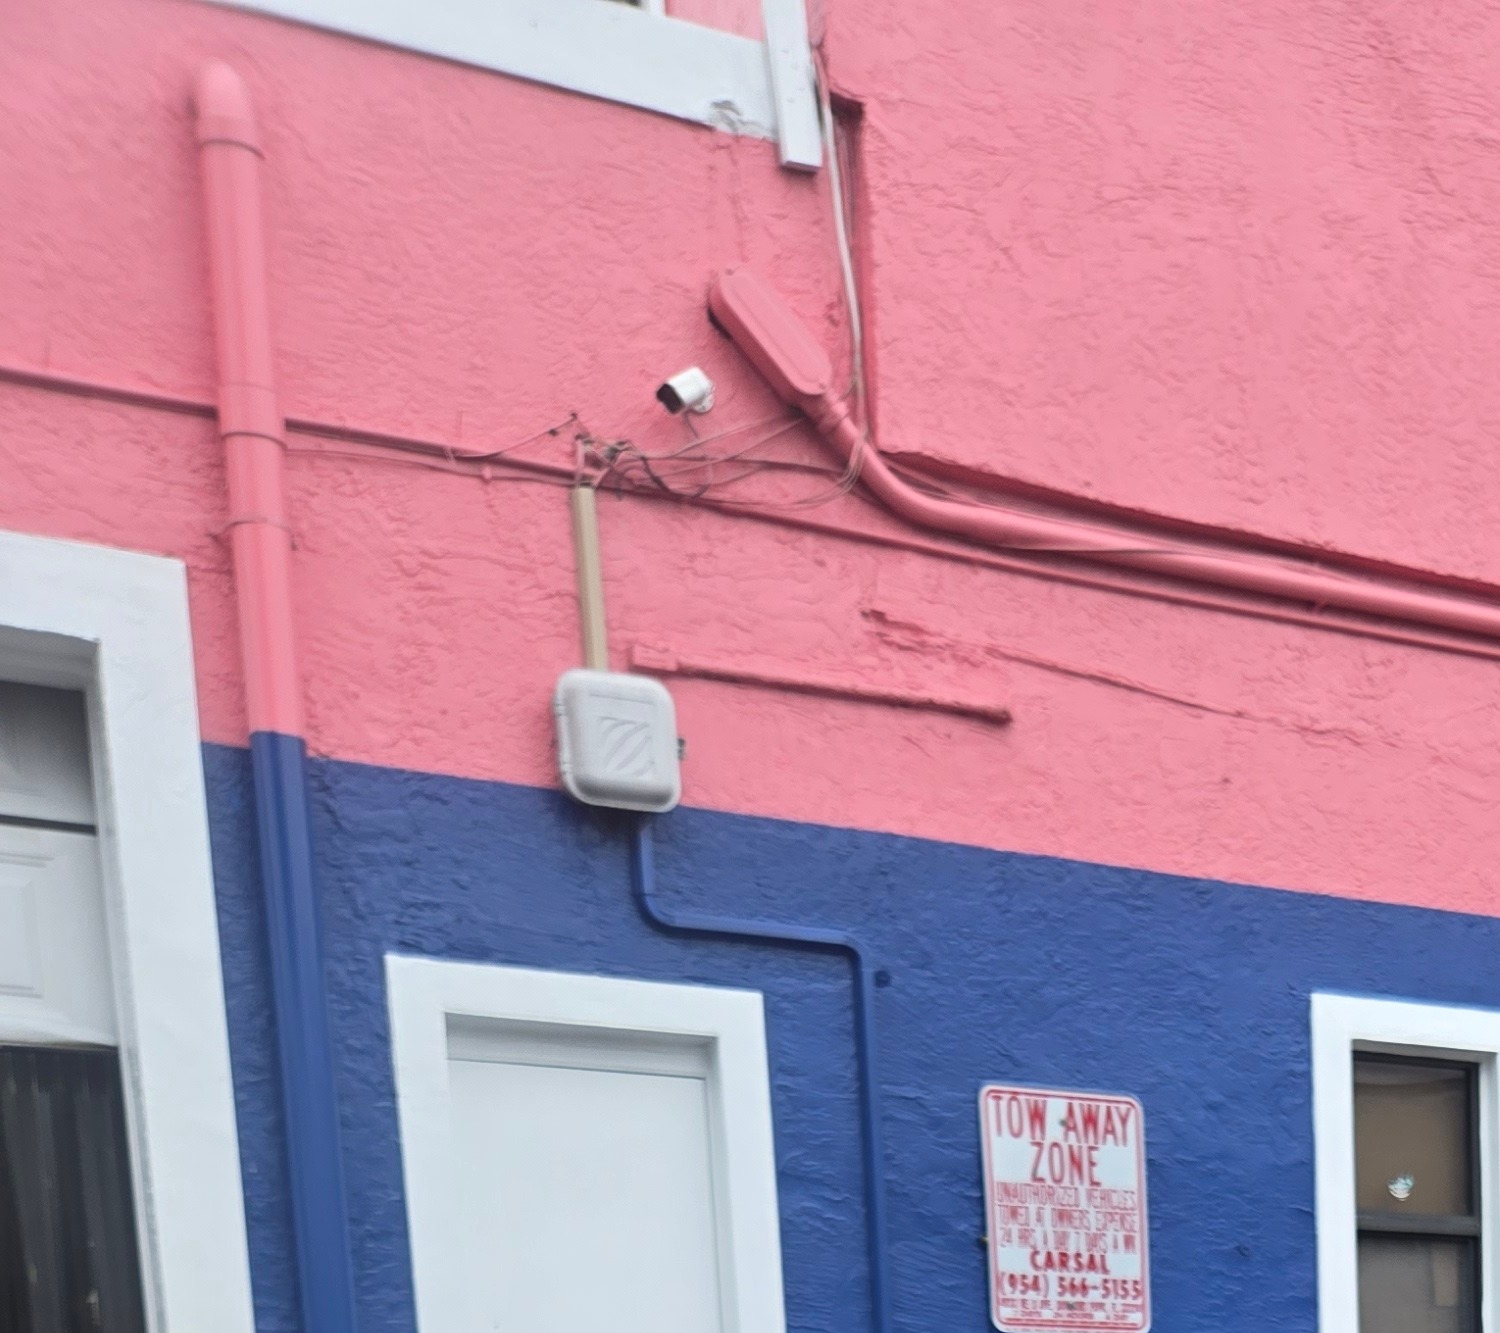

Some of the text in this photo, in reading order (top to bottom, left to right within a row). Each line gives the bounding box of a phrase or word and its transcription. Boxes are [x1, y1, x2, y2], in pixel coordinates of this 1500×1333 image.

[991, 1095, 1132, 1147] TOW AWAY
[1030, 1142, 1101, 1187] ZONE
[1029, 1250, 1110, 1274] CARSAL
[1000, 1273, 1142, 1301] (954) 566-5155
